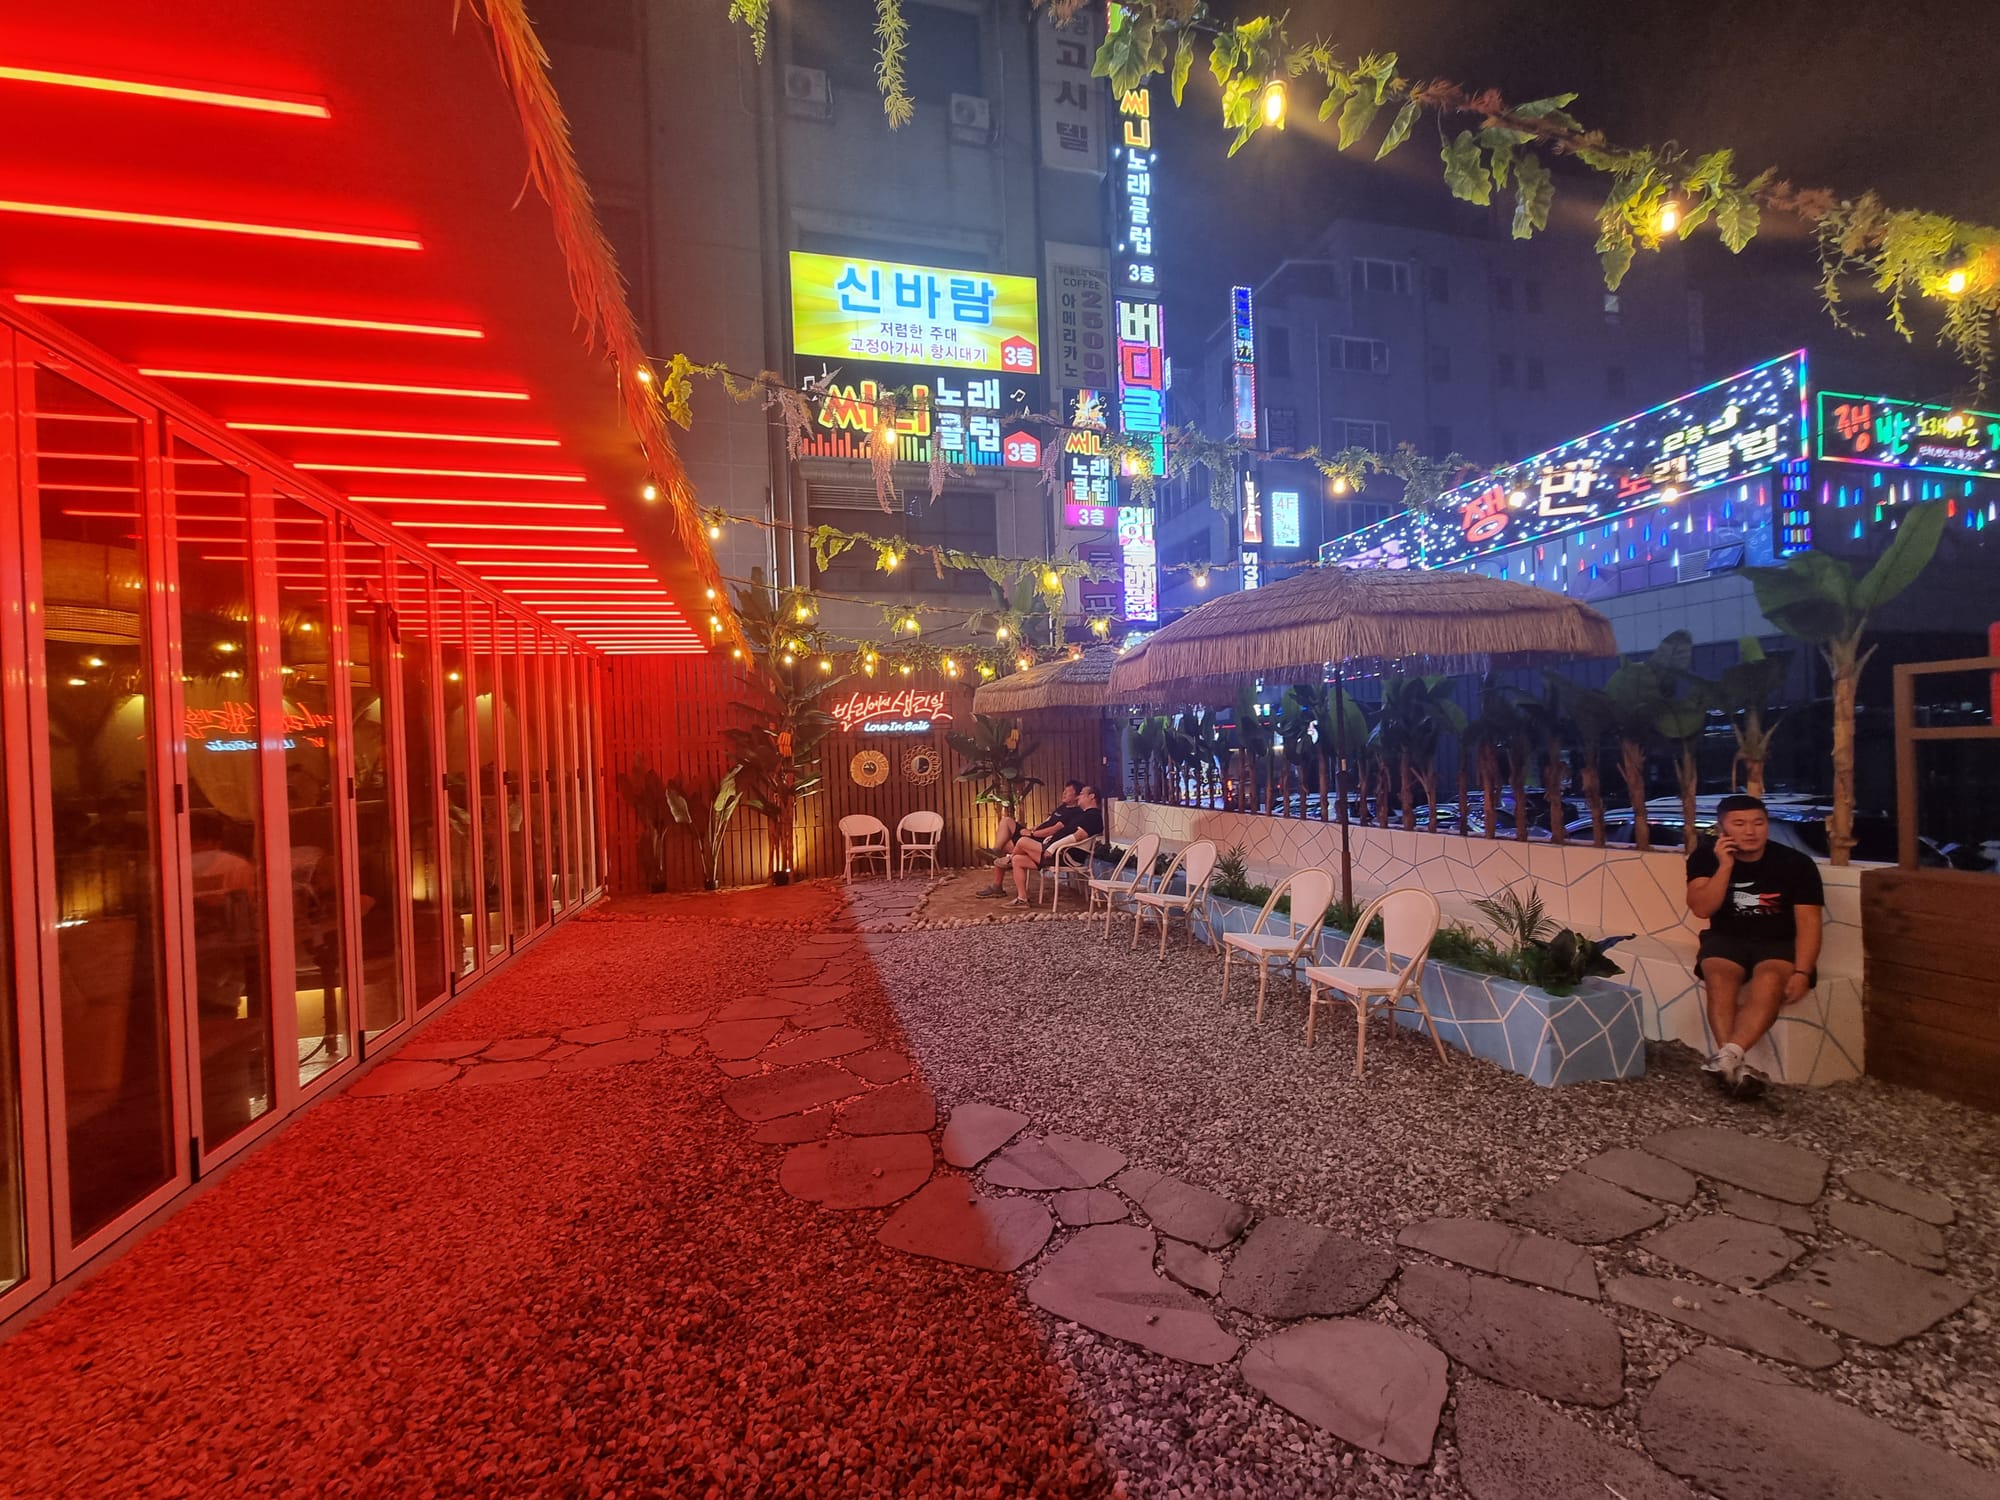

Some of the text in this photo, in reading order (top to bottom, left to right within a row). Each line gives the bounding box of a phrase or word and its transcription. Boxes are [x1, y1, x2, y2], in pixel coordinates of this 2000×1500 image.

[1120, 88, 1152, 255] 써니 노래클럽
[1063, 278, 1101, 290] COFFEE
[1128, 263, 1155, 283] 3층
[836, 266, 995, 326] 신바람
[880, 321, 957, 342] 저렴한 주대
[1062, 293, 1078, 378] 아메리카노
[850, 337, 987, 363] 고정아가씨 항시대기
[1004, 346, 1034, 368] 3층
[935, 377, 1001, 410] 노래
[1663, 424, 1703, 452] 2층
[1007, 442, 1037, 462] 3층
[1071, 457, 1110, 478] 노래
[1073, 478, 1109, 502] 클럽
[1078, 508, 1105, 526] 3층
